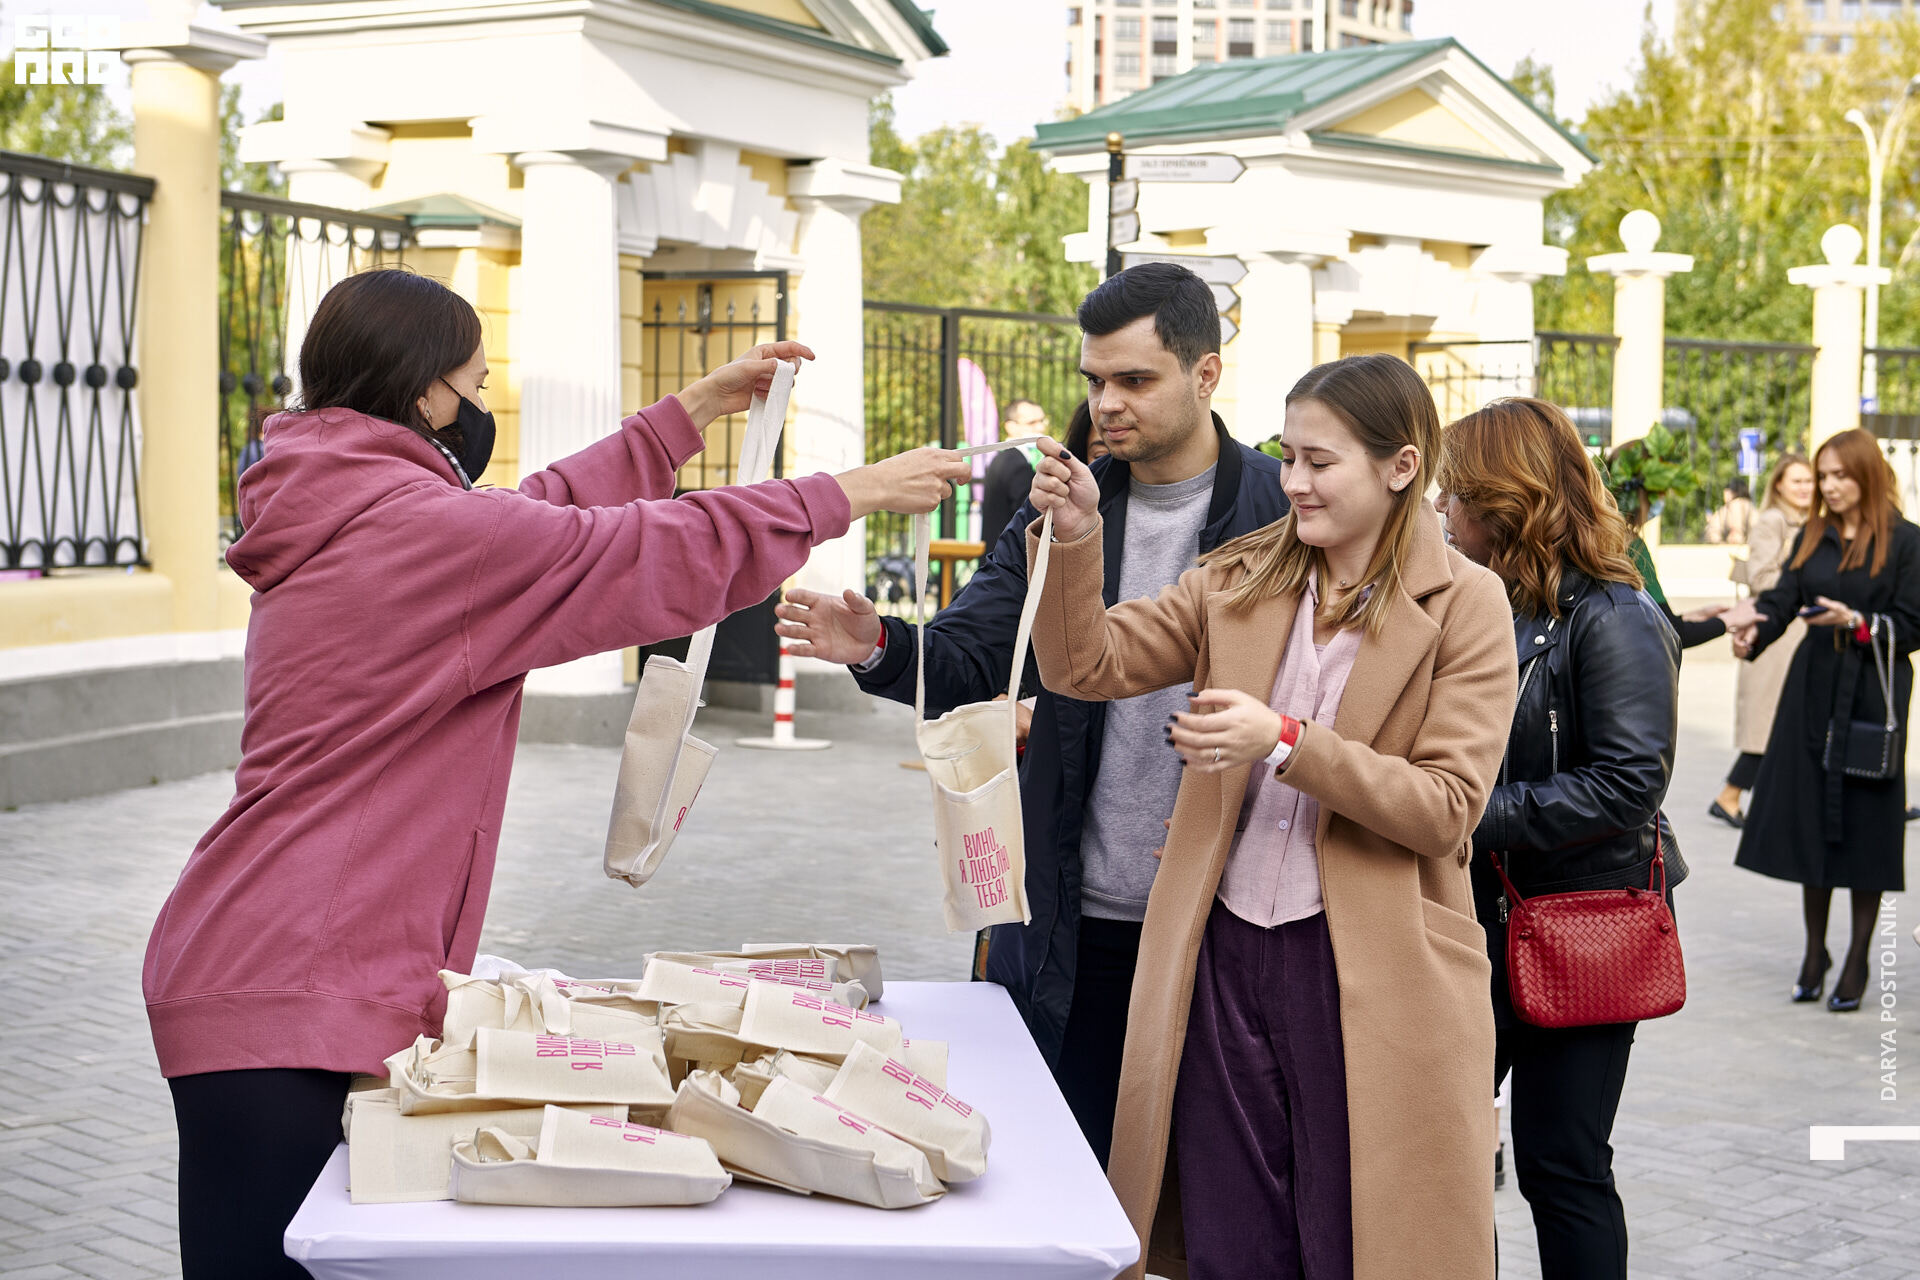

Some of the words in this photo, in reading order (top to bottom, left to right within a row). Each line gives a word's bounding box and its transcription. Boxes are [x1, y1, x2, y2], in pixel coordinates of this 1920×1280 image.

[963, 826, 999, 859] ВИНО,
[959, 859, 968, 884] Я
[974, 876, 1008, 908] ТЕБЯ!
[571, 1062, 603, 1071] Я
[905, 1091, 935, 1111] Я
